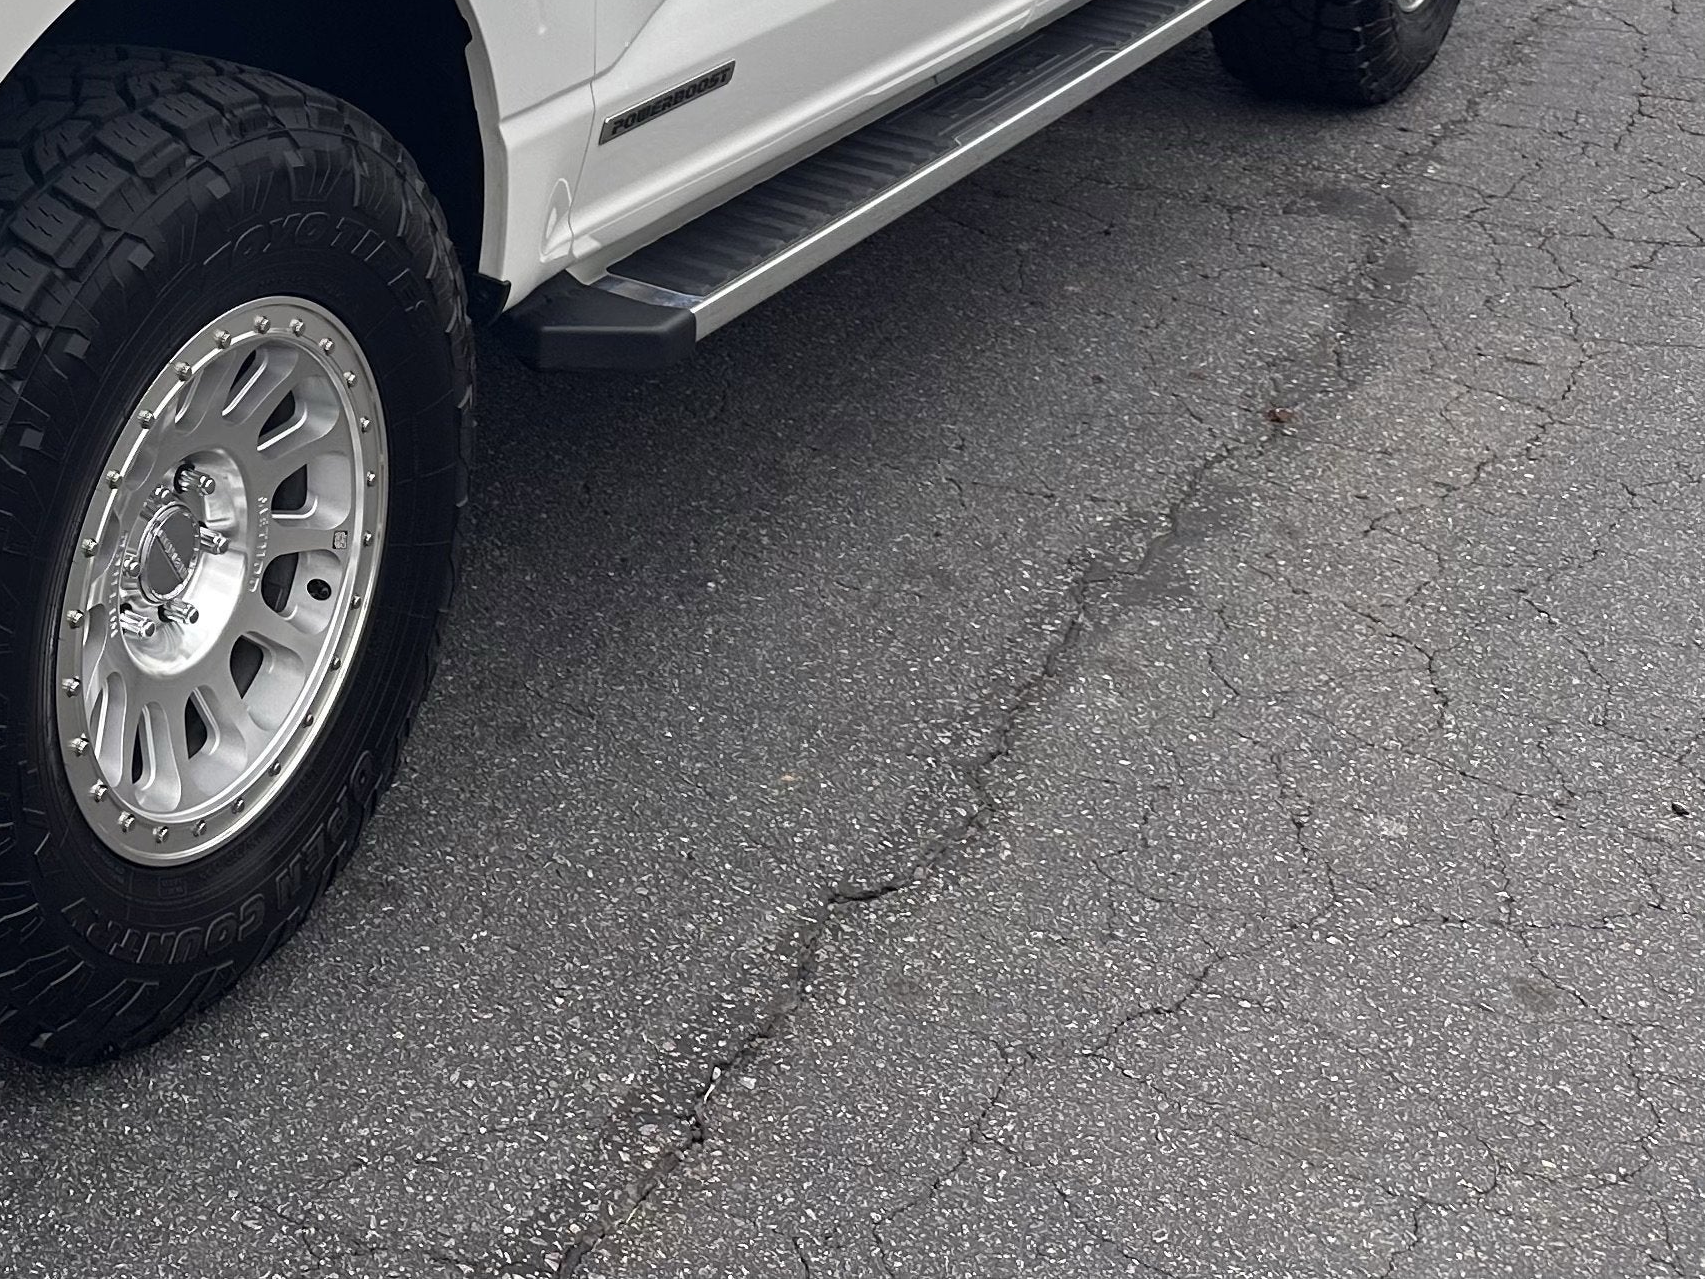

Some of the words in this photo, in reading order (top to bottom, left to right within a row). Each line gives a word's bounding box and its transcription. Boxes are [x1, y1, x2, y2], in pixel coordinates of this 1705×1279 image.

[611, 68, 731, 136] POWERBOOST
[277, 749, 374, 910] OPEN
[60, 893, 266, 965] COUNTRY
